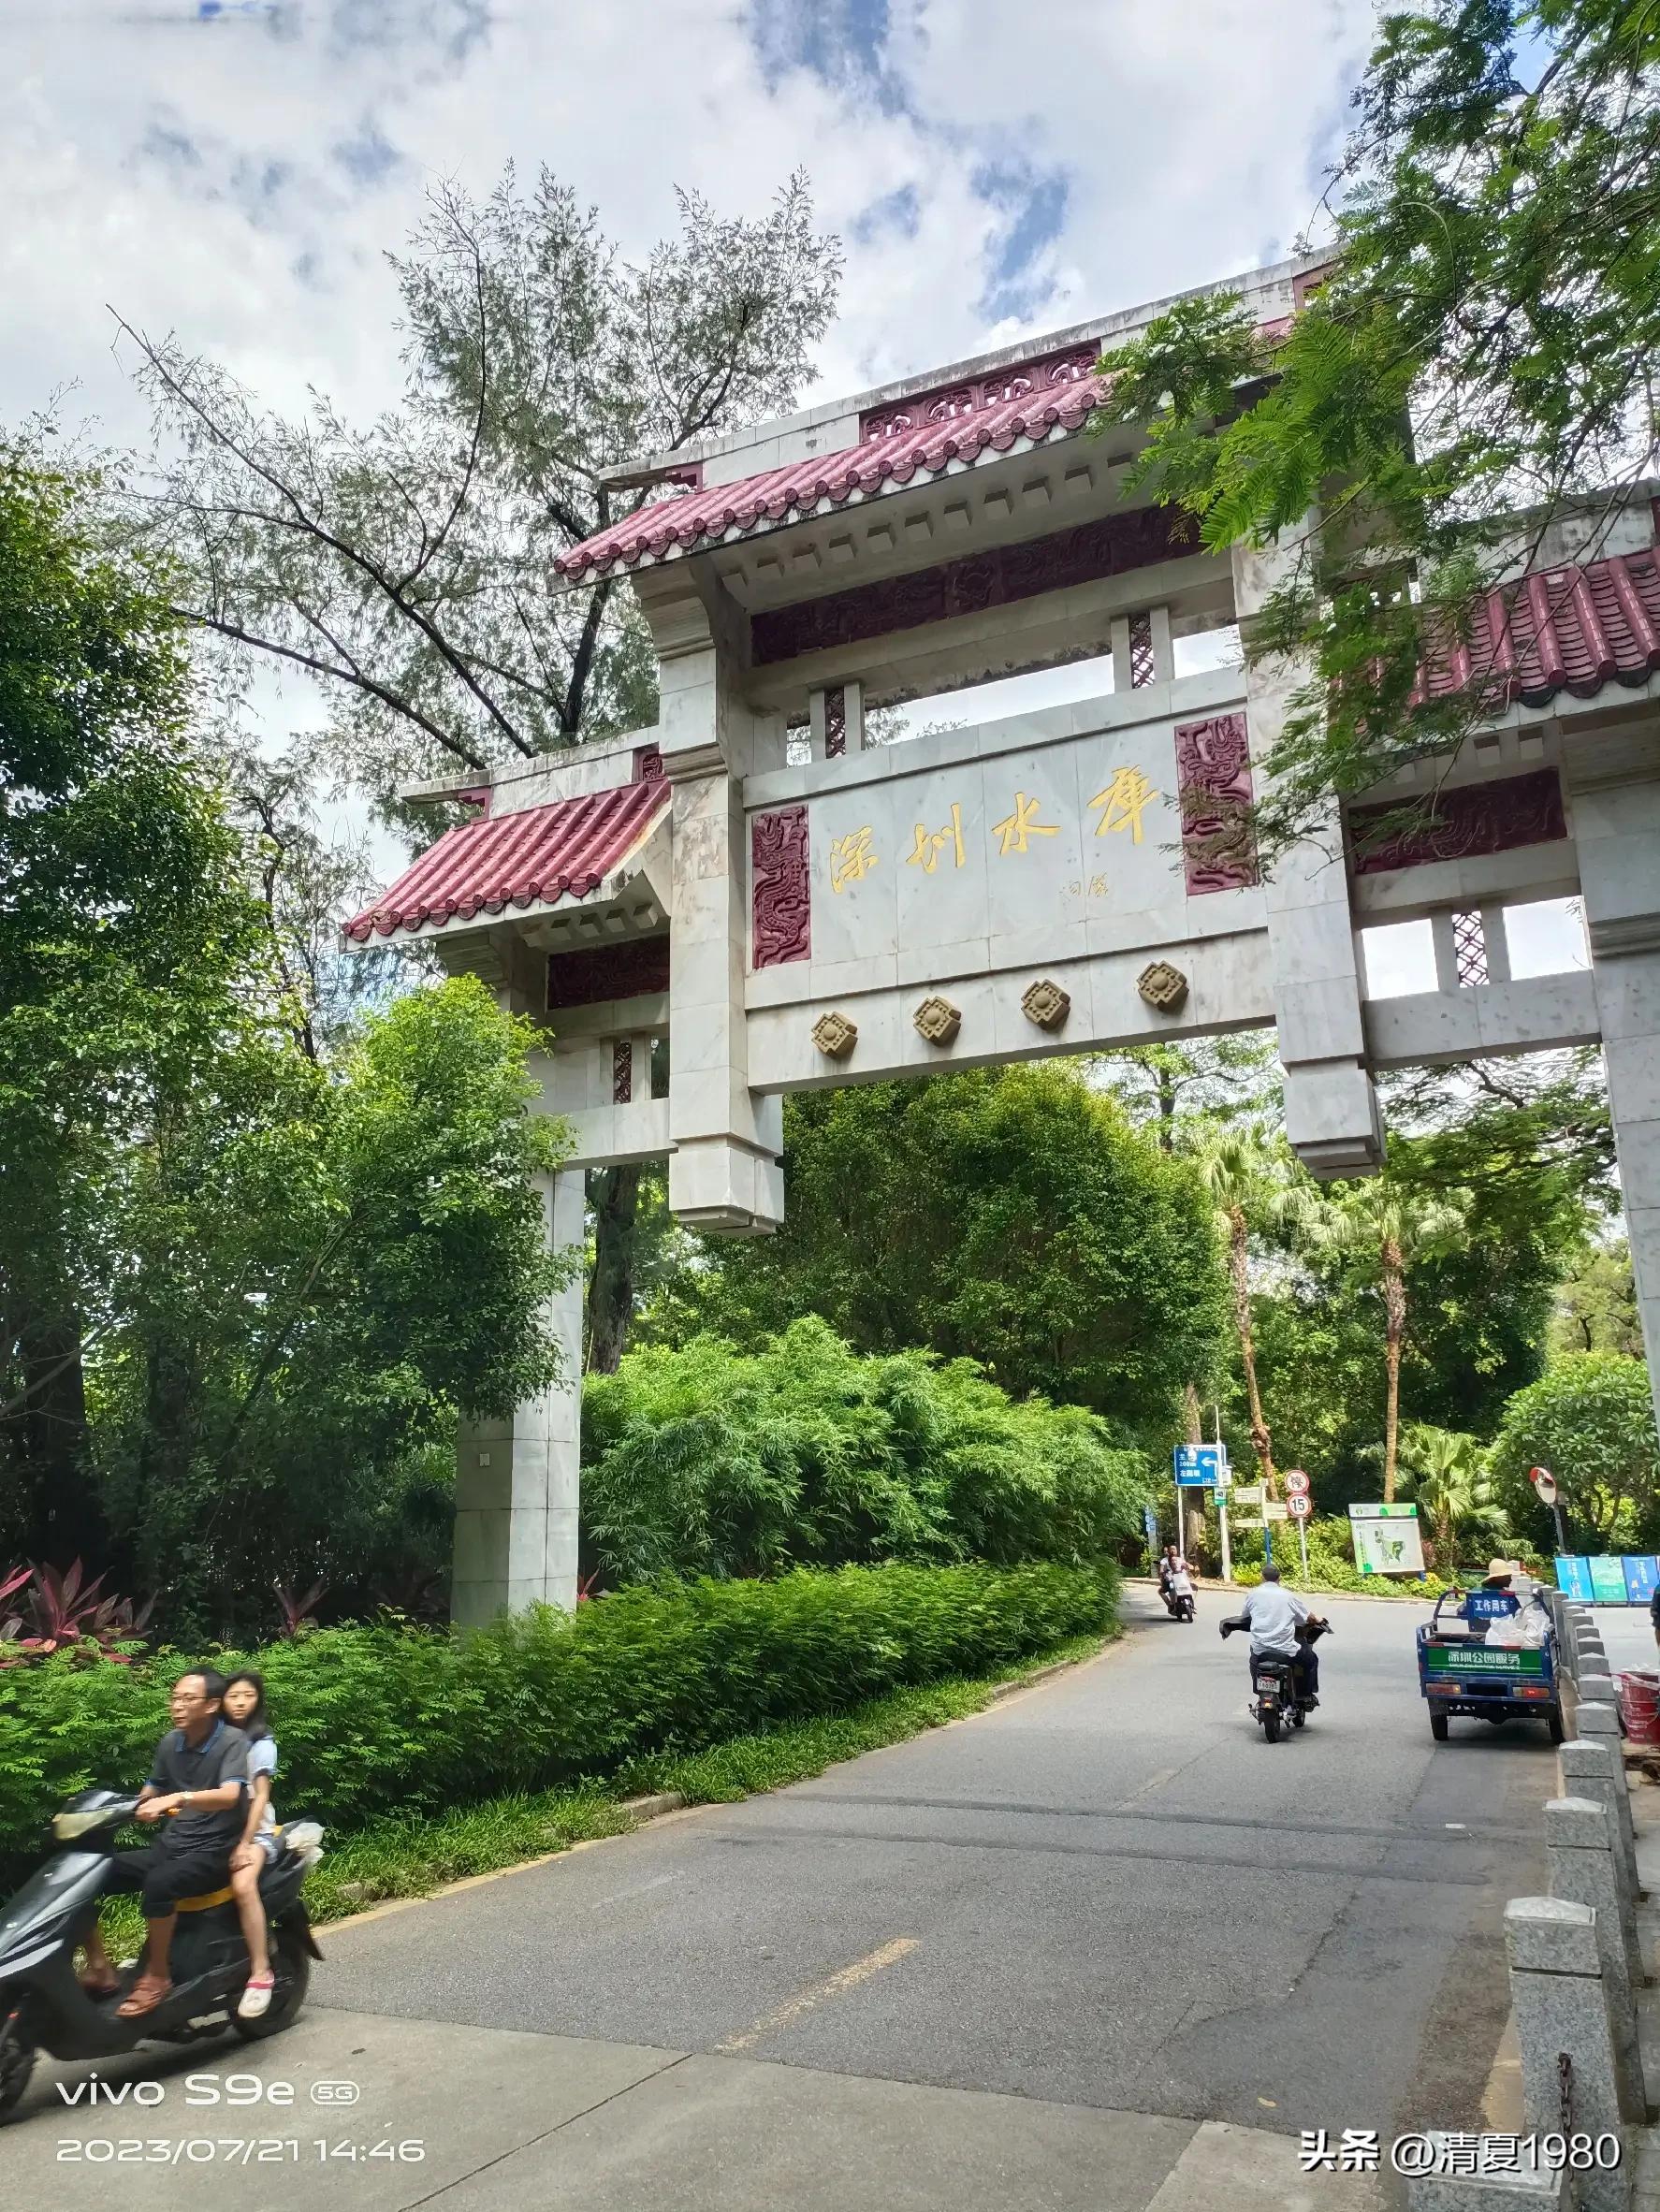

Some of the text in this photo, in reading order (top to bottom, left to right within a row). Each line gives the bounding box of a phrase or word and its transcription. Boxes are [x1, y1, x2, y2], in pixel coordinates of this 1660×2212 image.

[829, 764, 1159, 895] 深圳水库
[1291, 1498, 1305, 1512] 15
[1475, 1599, 1508, 1612] 工作用车
[1448, 1651, 1521, 1665] 深圳公园服务
